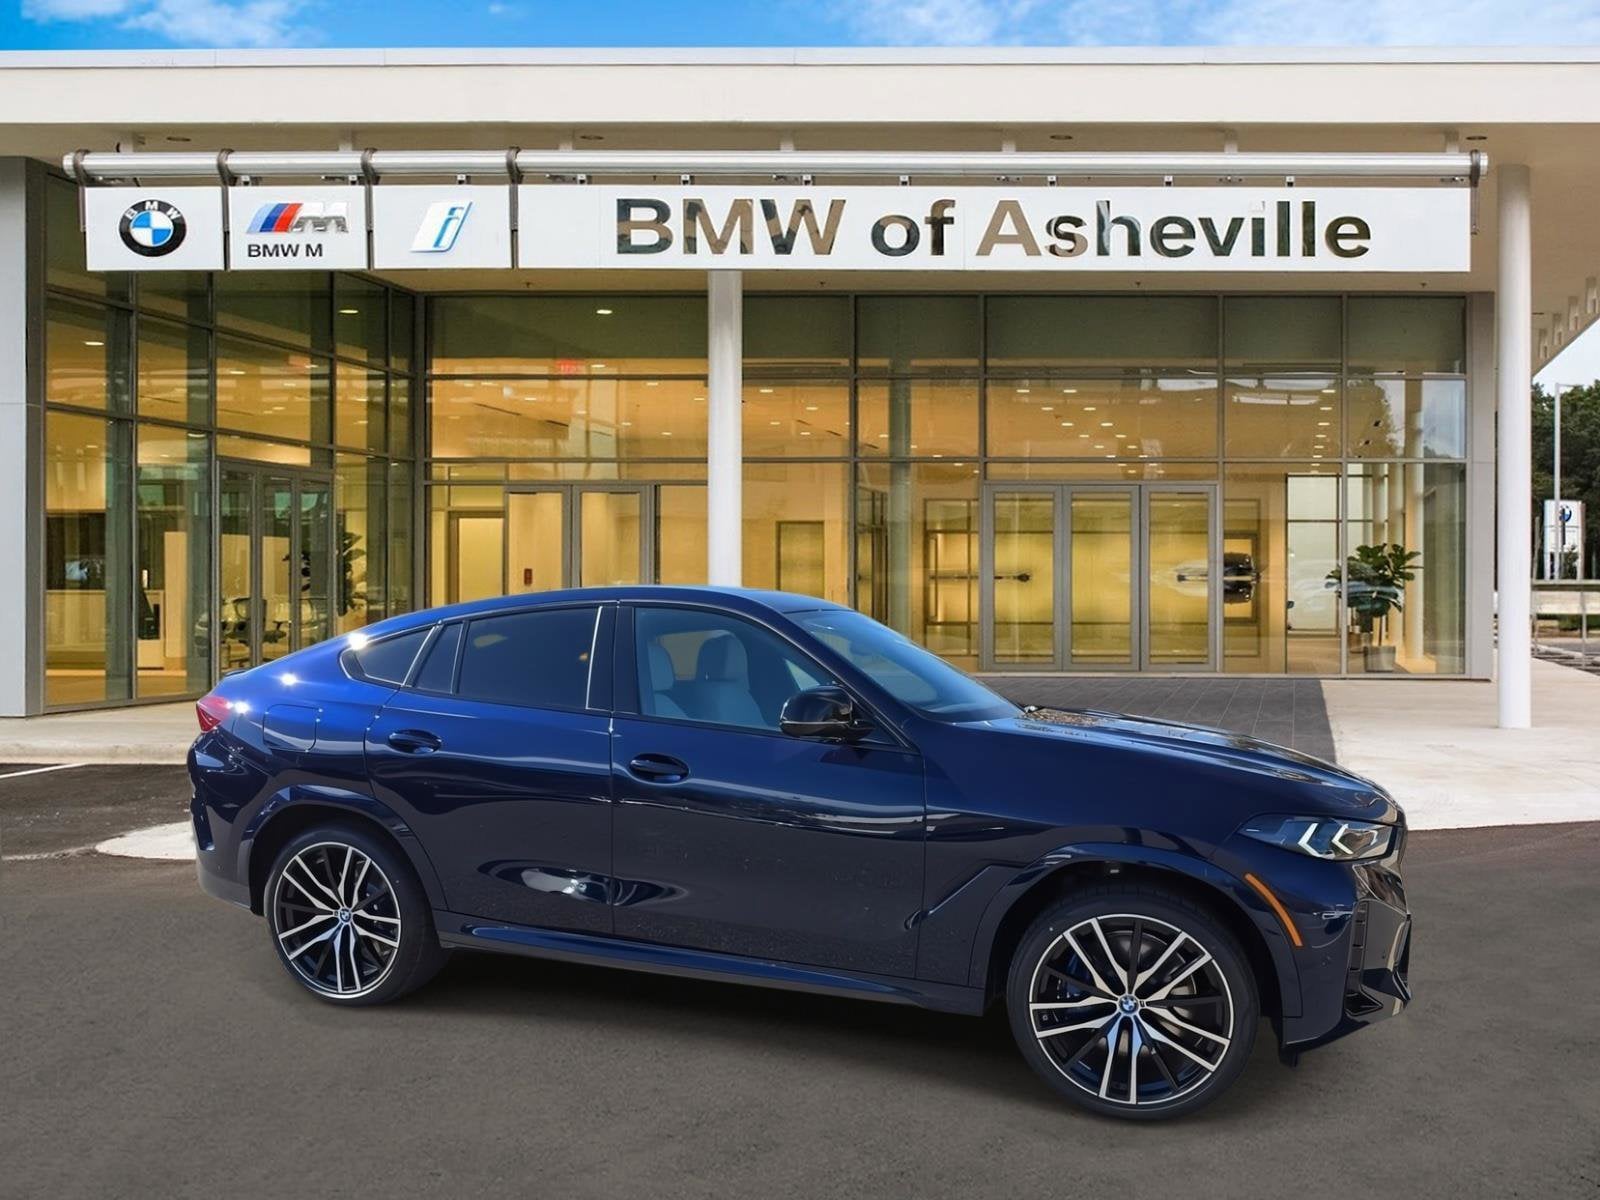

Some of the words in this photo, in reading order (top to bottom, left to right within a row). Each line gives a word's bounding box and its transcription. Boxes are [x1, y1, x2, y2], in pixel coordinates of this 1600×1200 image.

[124, 201, 181, 220] BMW
[616, 198, 846, 255] BMW
[871, 199, 956, 257] of
[975, 199, 1372, 258] Asheville
[247, 243, 300, 257] BMW
[305, 243, 323, 257] M
